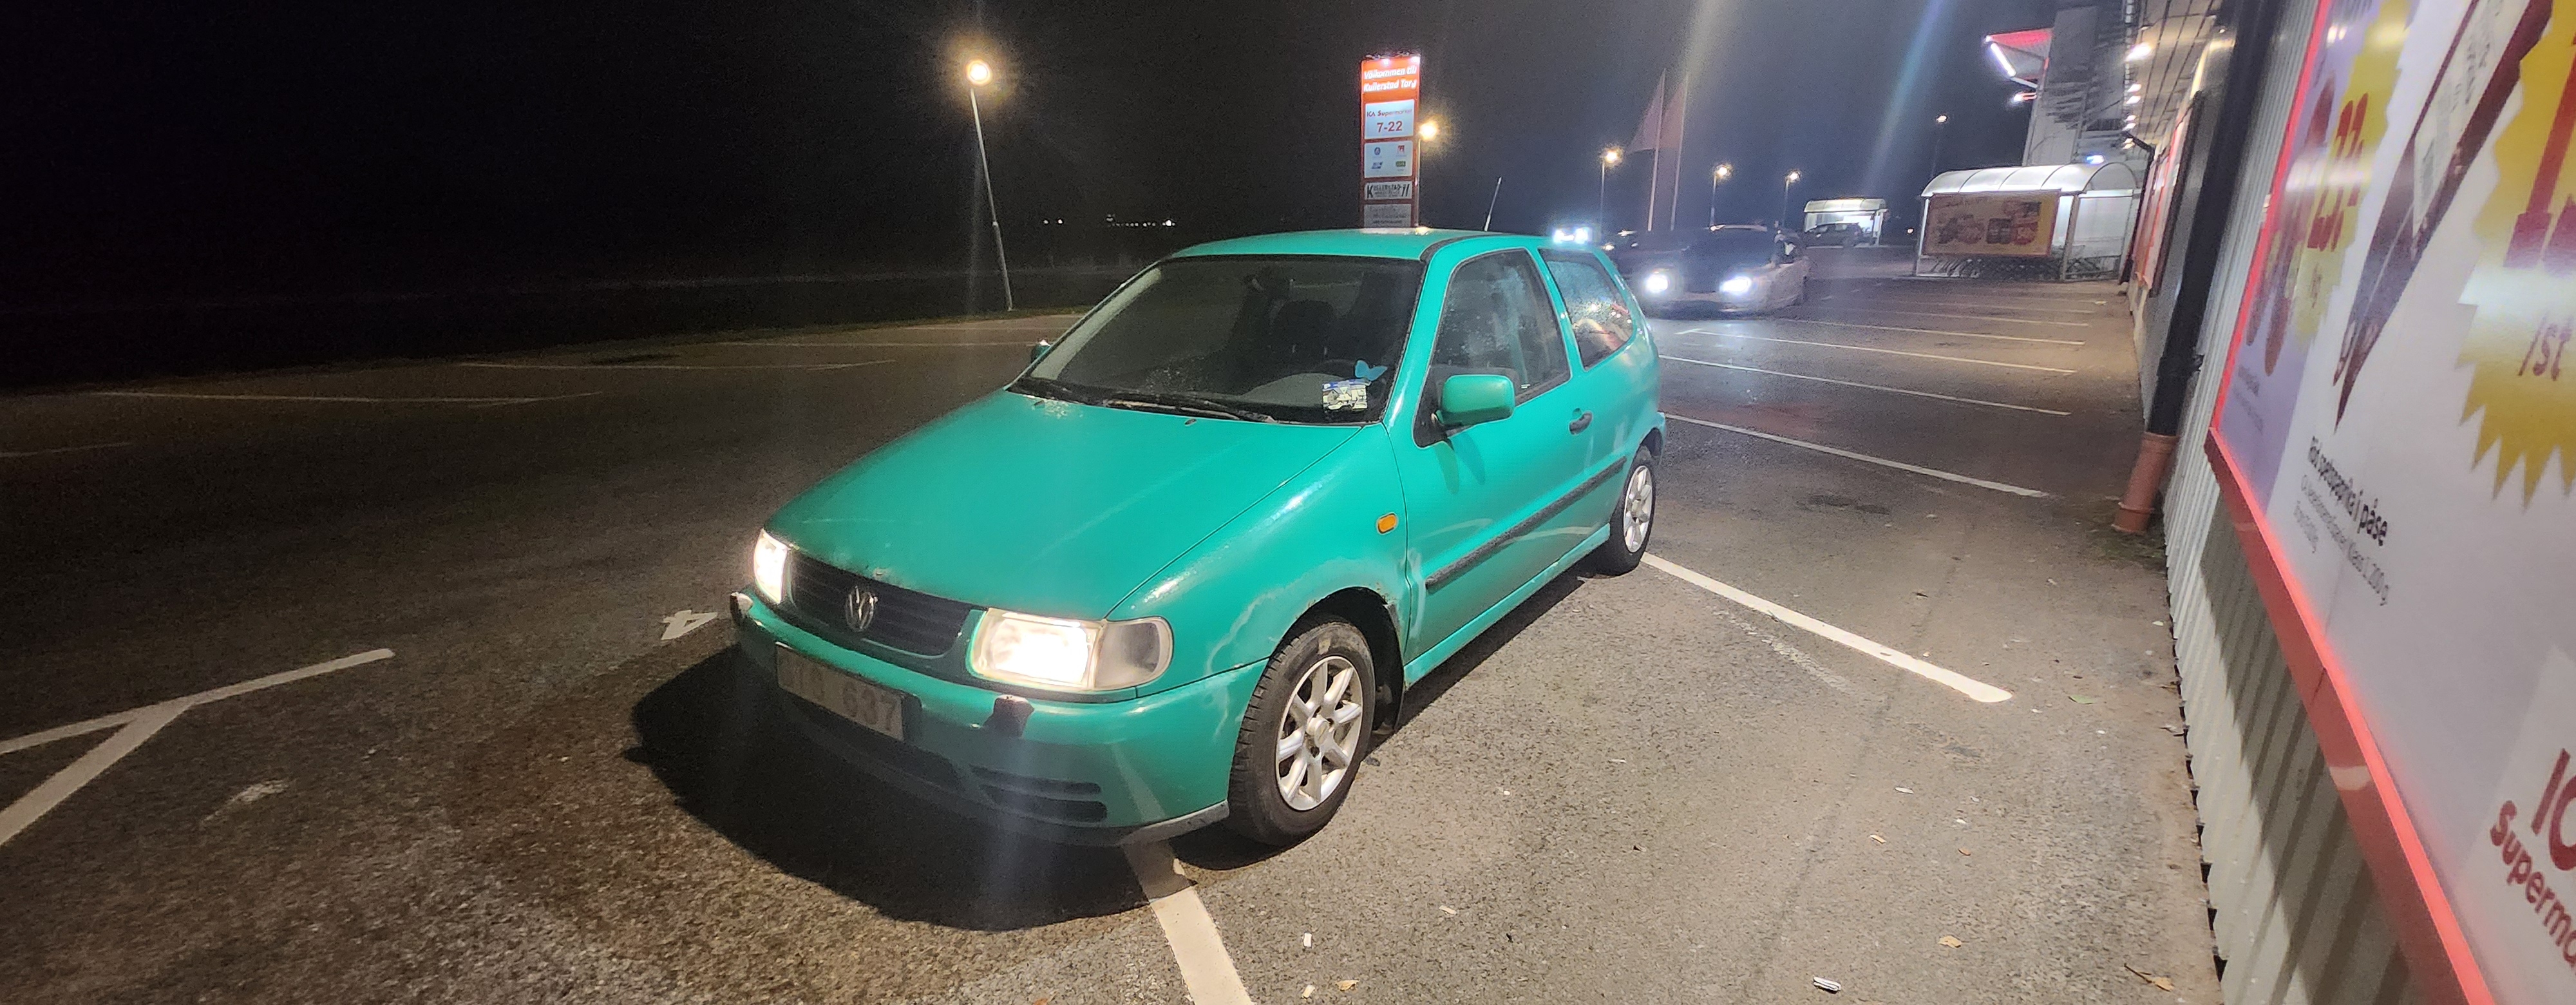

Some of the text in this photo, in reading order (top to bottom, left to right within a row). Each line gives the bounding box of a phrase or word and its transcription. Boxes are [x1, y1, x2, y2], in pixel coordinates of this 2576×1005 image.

[1364, 80, 1399, 92] Kullerstad
[1377, 120, 1403, 133] 7-22
[2357, 498, 2387, 546] påse
